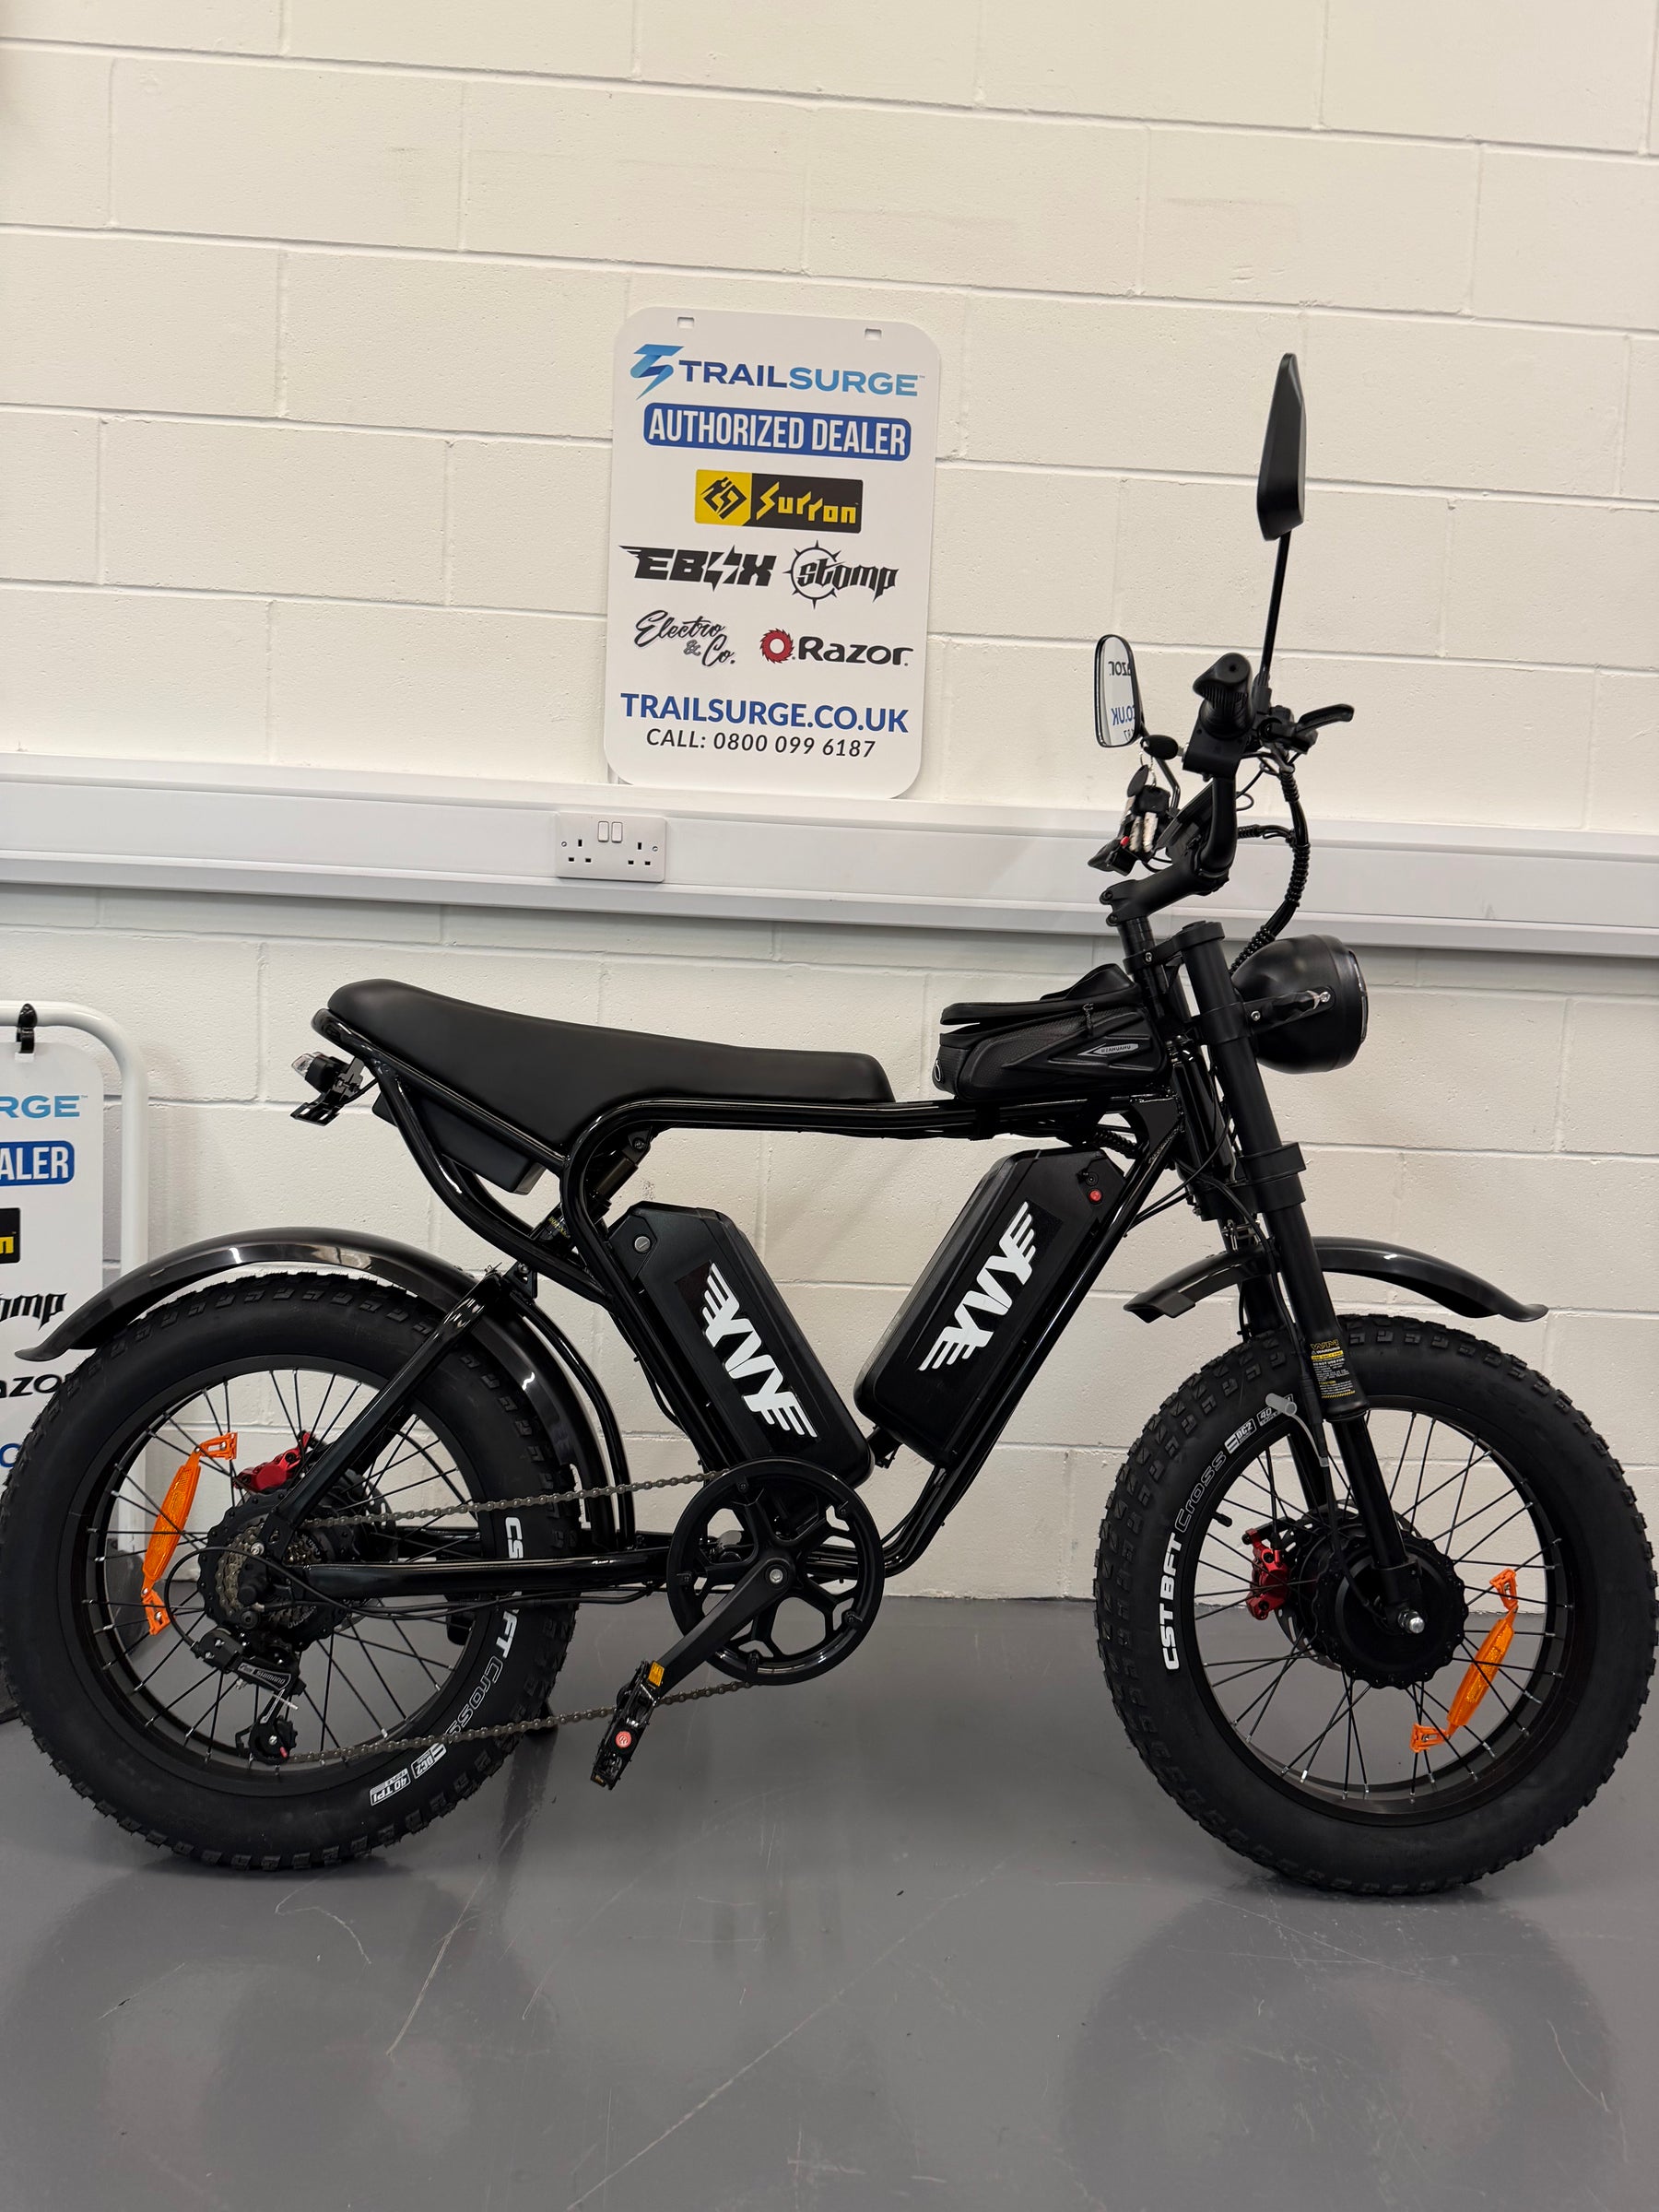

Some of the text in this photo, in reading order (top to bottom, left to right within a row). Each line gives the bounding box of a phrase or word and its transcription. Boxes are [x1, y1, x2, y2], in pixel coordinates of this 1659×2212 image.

[678, 359, 918, 397] TRAILSURGE
[648, 408, 907, 456] AUTHORIZED DEALER
[756, 481, 856, 524] Surron
[634, 610, 725, 647] Electro
[684, 634, 735, 666] & Co.
[620, 693, 909, 734] TRAILSURGE.CO.UK
[646, 728, 876, 759] CALL: 0800 099 6187
[1159, 1451, 1227, 1670] CST BFT Cross
